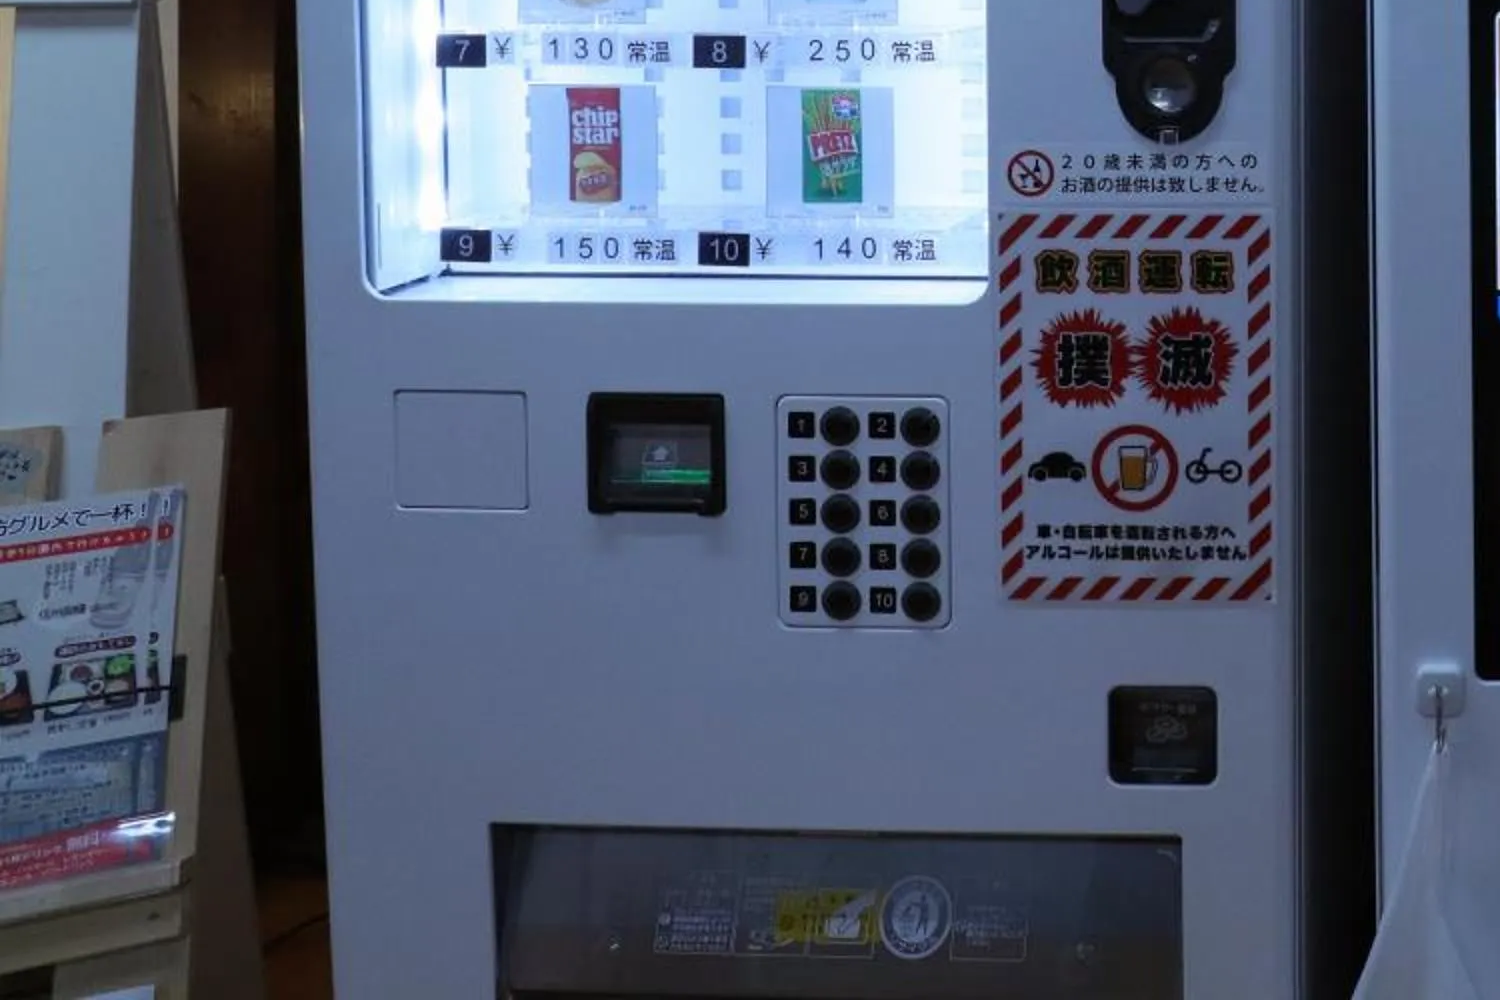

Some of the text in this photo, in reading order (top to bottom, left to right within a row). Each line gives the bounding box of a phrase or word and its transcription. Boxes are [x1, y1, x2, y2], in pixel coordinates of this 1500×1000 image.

[454, 38, 672, 64] 7 ¥ 130 常温
[711, 38, 936, 64] 8 ¥ 250 常温
[571, 105, 619, 127] chip
[572, 127, 619, 145] star
[457, 235, 676, 262] 9 ¥ 150 常温
[709, 237, 937, 263] 10 ¥ 140 常温
[1034, 249, 1235, 294] 飲酒運転
